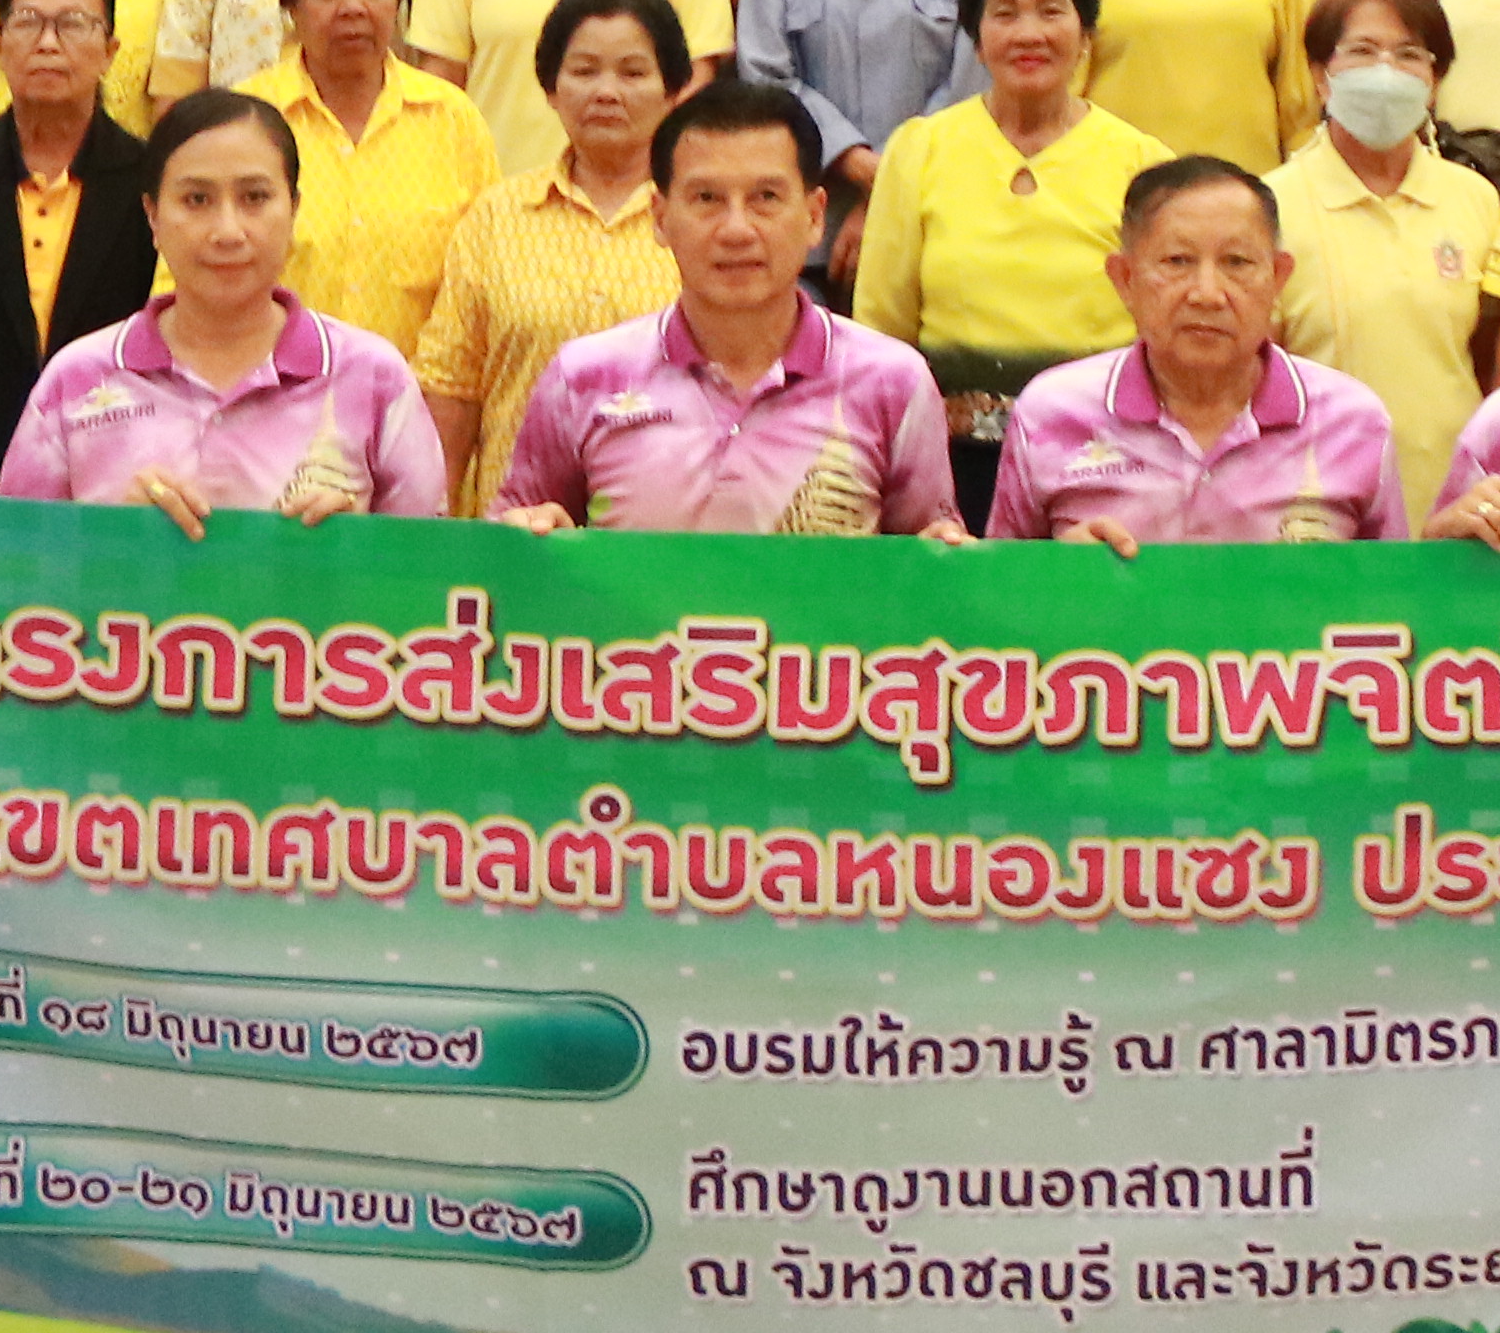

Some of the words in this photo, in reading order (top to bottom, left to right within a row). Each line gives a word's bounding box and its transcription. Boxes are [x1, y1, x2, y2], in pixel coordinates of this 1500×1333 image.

[41, 1000, 111, 1033] ๑๘
[124, 997, 307, 1059] มิถุนายน
[324, 1024, 481, 1068] ๒๕๖๗
[682, 1011, 1093, 1094] อบรมให้ความรู้
[1115, 1033, 1176, 1072] ณ
[40, 1166, 210, 1215] ๒๐-๒๑
[226, 1172, 414, 1234] มิถุนายน
[430, 1194, 581, 1246] ๒๕๖๗
[689, 1127, 1315, 1233] ศึกษาดูงานนอกสถานที่
[687, 1257, 748, 1298] ณ
[772, 1241, 1113, 1322] จังหวัดชลบุรี
